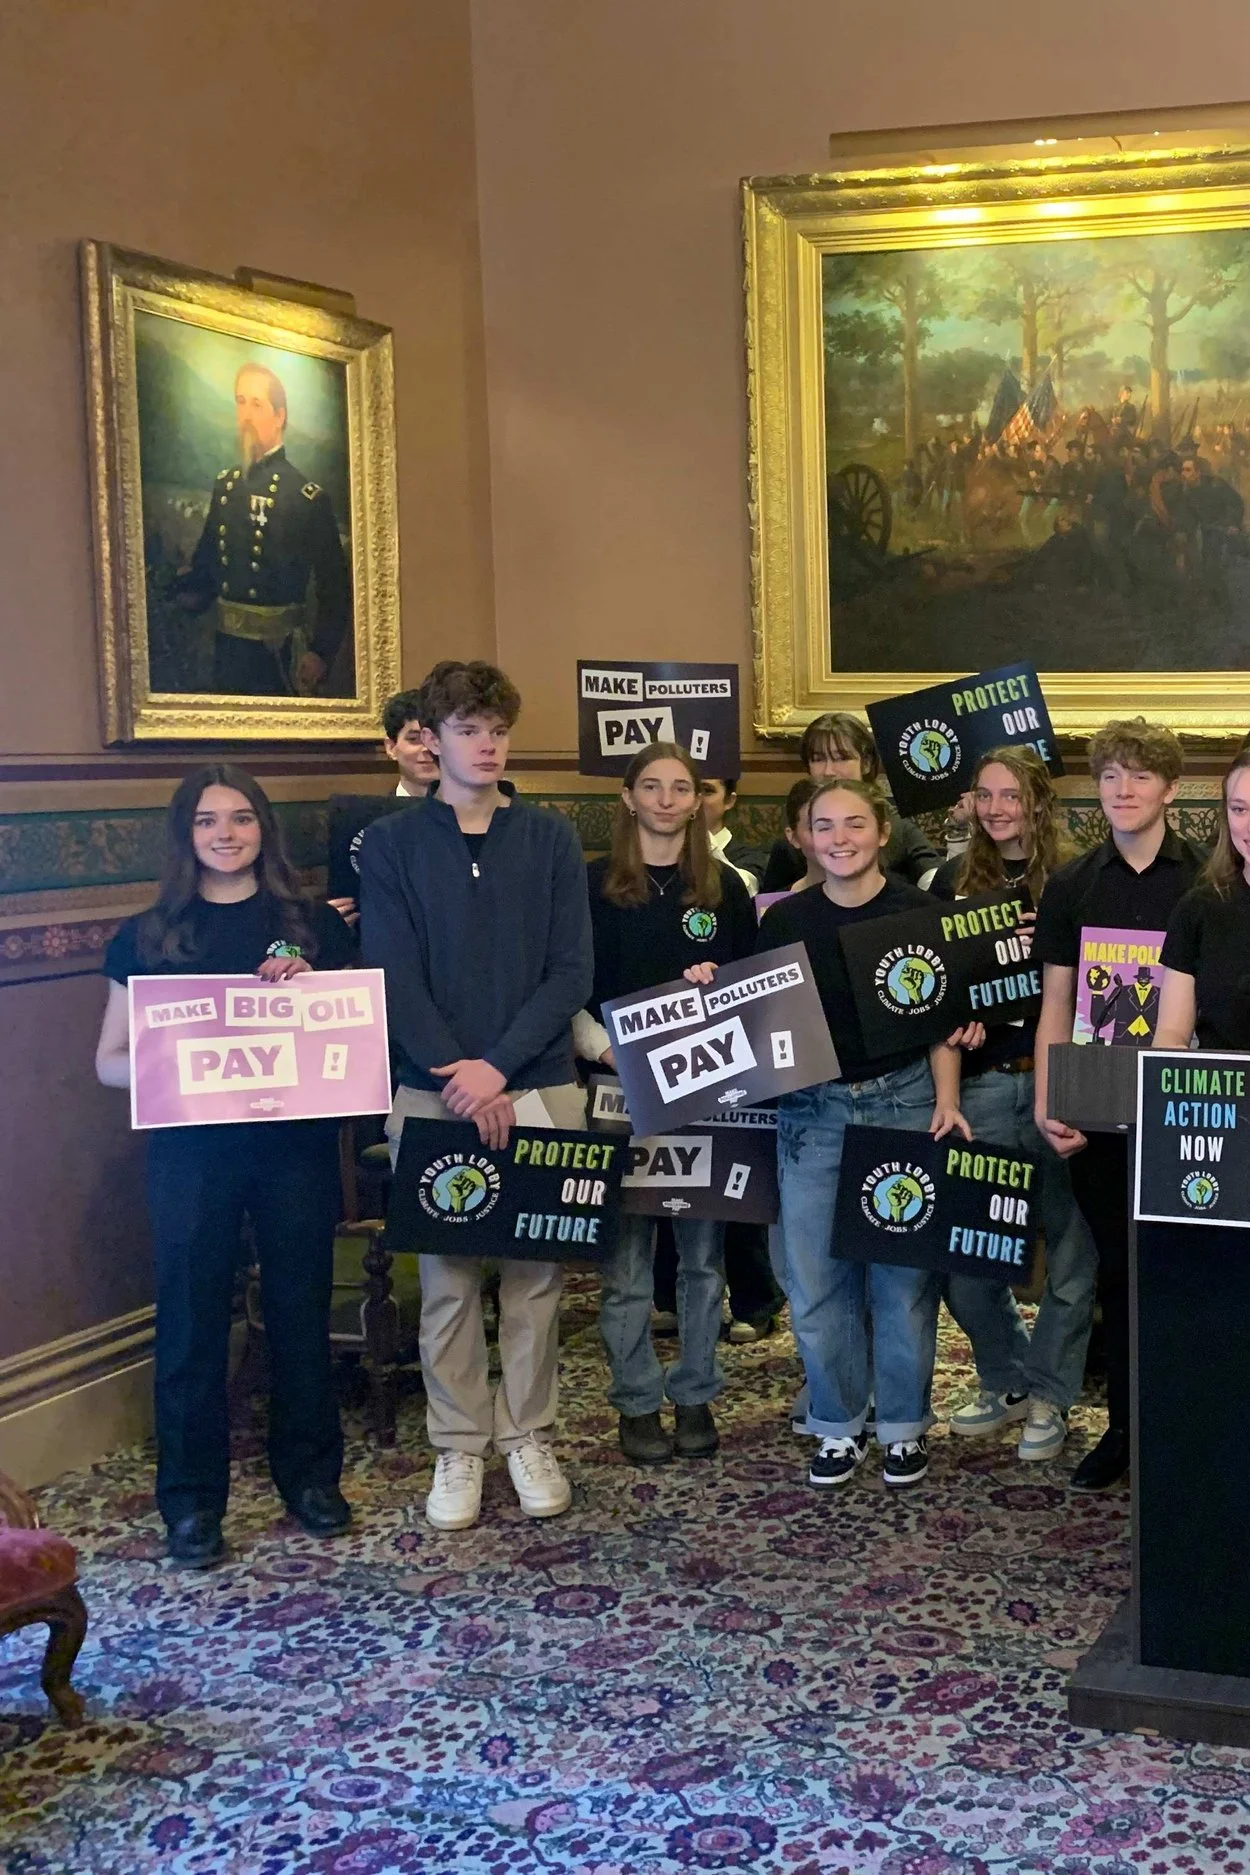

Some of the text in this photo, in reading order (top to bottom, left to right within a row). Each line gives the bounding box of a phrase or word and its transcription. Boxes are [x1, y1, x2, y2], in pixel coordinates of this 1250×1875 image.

[584, 675, 728, 695] MAKE POLLUTERS
[951, 674, 1030, 716] PROTECT
[604, 717, 664, 746] PAY
[899, 718, 959, 756] YOUTH LOBBY
[1002, 706, 1041, 736] OUR
[902, 743, 962, 781] CLIMATE JOBS JUSTICE
[941, 900, 1025, 941] PROTECT
[874, 944, 945, 986] YOUTH LOBBY
[1084, 941, 1125, 964] MAKE
[619, 968, 800, 1036] MAKE POLLUTERS
[877, 974, 948, 1015] CLIMATE JOBS JUSTICE
[968, 970, 1042, 1010] FUTURE
[151, 996, 365, 1024] MAKE BIG OIL
[190, 1044, 283, 1082] PAY
[659, 1031, 735, 1089] PAY
[1161, 1068, 1246, 1097] CLIMATE
[702, 1111, 778, 1125] LLUTERS
[1164, 1101, 1236, 1129] ACTION
[514, 1139, 615, 1170] PROTECT
[624, 1146, 701, 1176] PAY
[1180, 1134, 1224, 1162] NOW
[419, 1153, 500, 1191] YOUTH LOBBY
[862, 1161, 936, 1202] YOUTH LOBBY
[946, 1149, 1034, 1191] PROTECT
[418, 1188, 499, 1223] CLIMATE JOBS JUSTICE
[561, 1178, 607, 1205] OUR
[515, 1212, 601, 1244] FUTURE
[860, 1196, 935, 1233] CLIMATE JOBS JUSTICE
[989, 1194, 1030, 1226] OUR
[949, 1226, 1025, 1265] FUTURE
